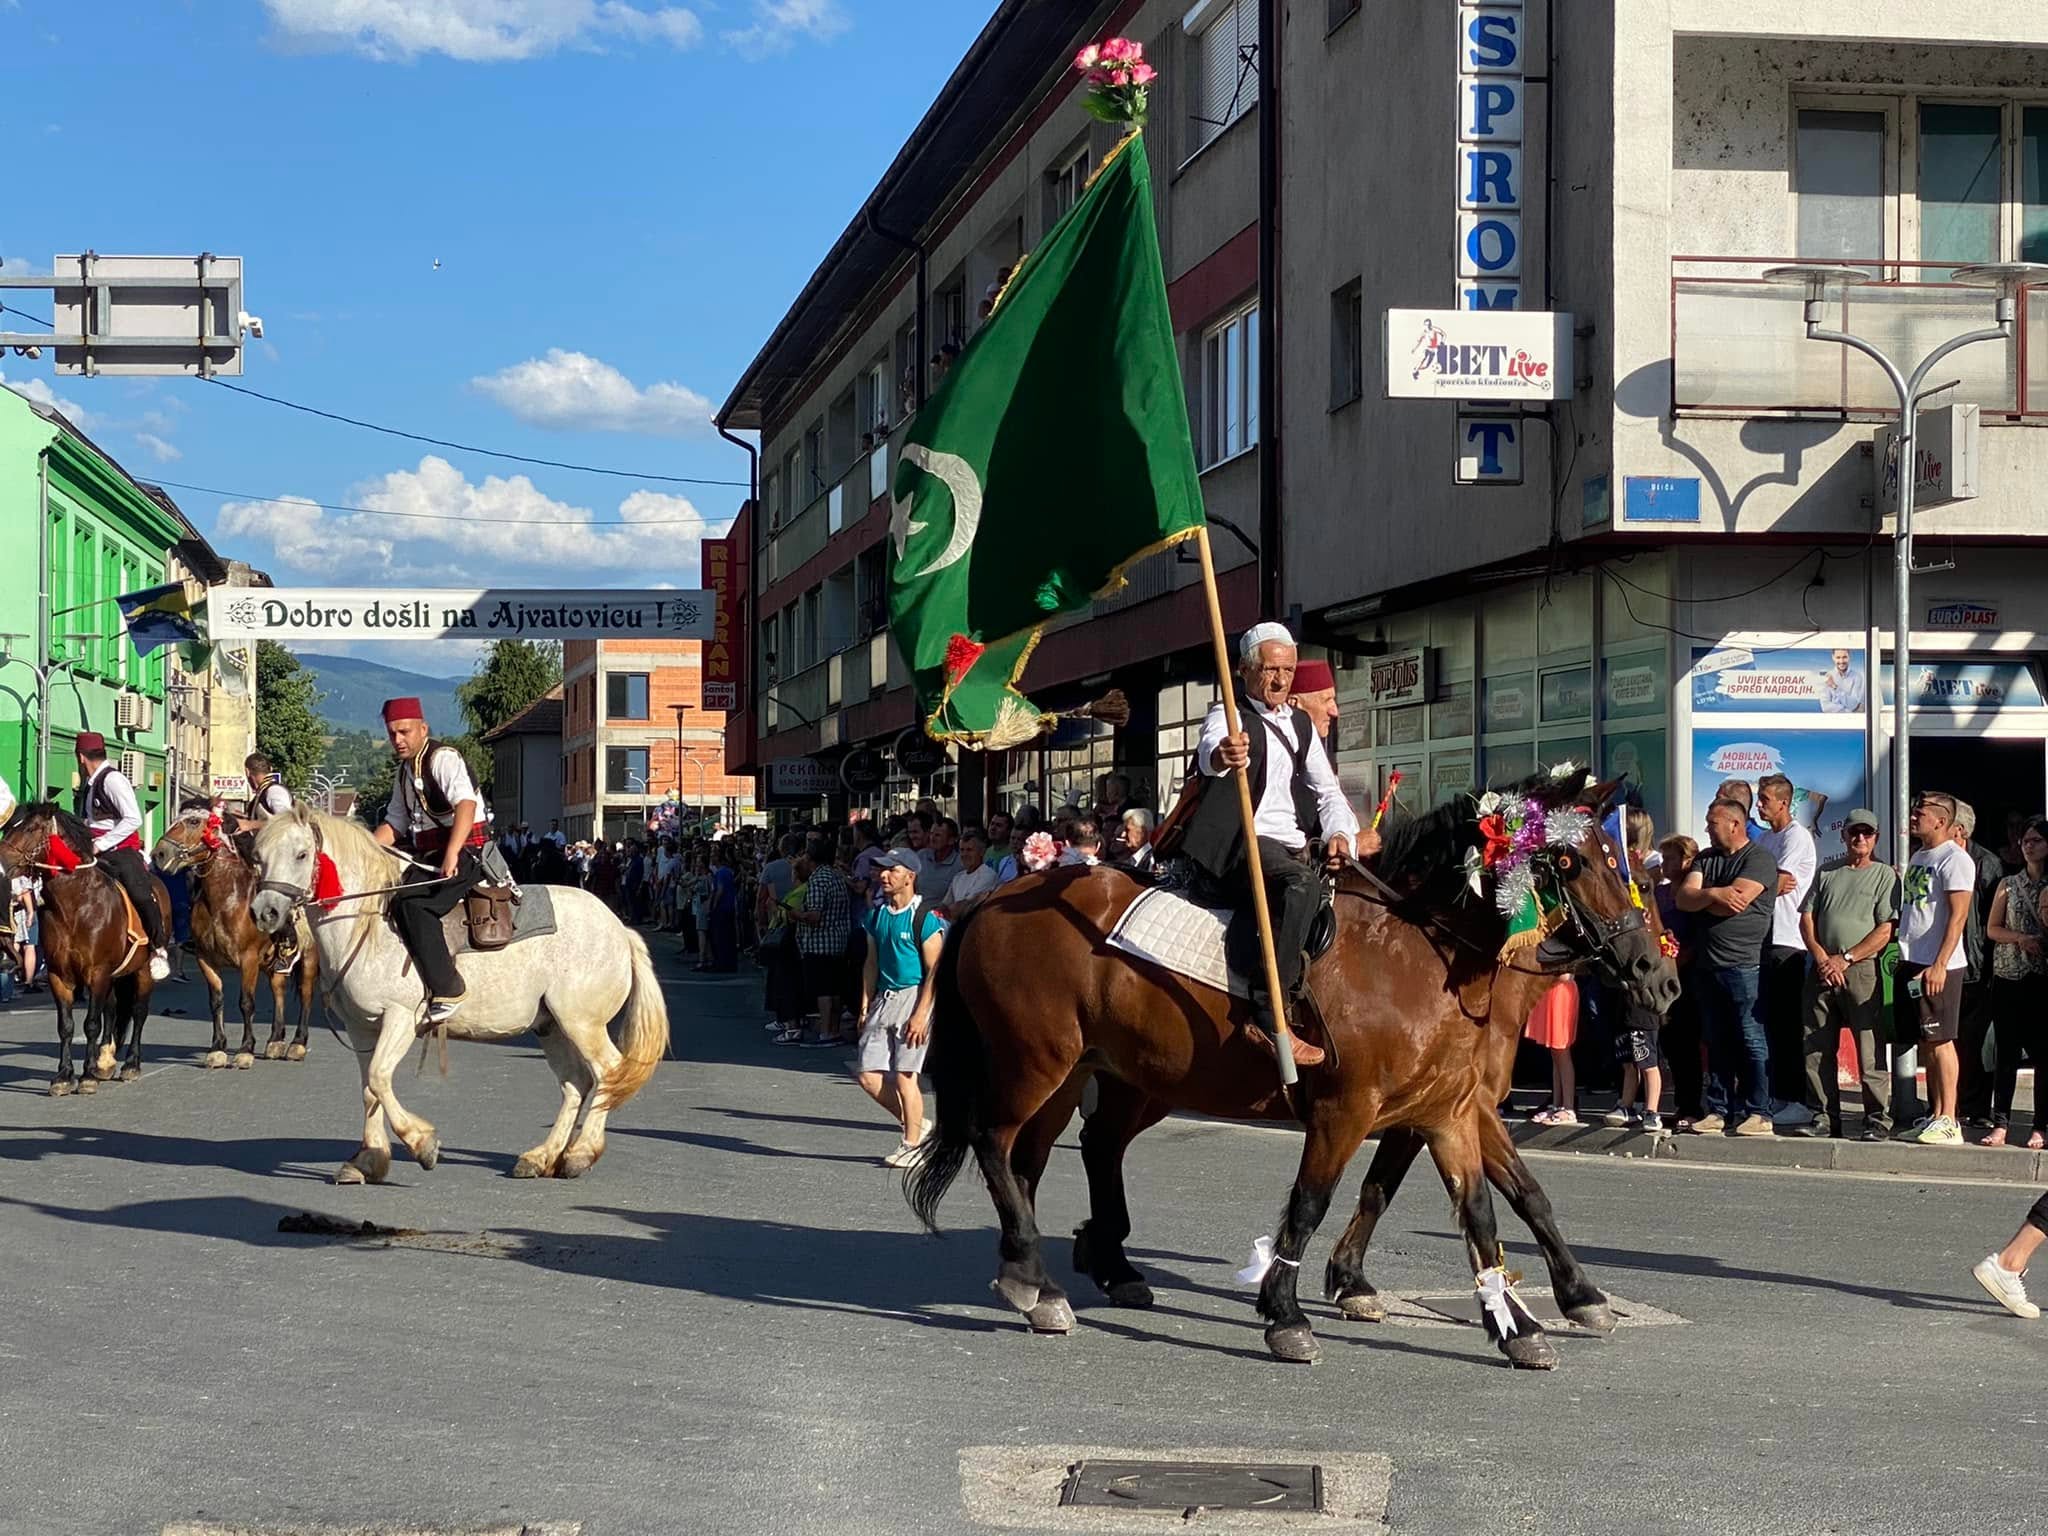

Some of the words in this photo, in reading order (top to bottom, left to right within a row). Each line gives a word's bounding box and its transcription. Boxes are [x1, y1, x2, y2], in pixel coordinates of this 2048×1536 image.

[1466, 15, 1517, 474] SPROT
[1436, 344, 1508, 376] BET
[1508, 351, 1549, 377] Live
[261, 599, 353, 628] Dobro
[363, 599, 431, 628] došli
[442, 607, 478, 628] na
[488, 600, 643, 634] Ajvatovicu
[655, 601, 665, 628] !
[709, 545, 730, 676] RESTORAN
[1929, 609, 1961, 625] EURO
[1963, 610, 1998, 625] PLAST
[1737, 675, 1769, 687] UVIJEK
[1771, 675, 1806, 685] KORAK
[1932, 679, 1974, 696] BET
[1727, 684, 1762, 695] ISPRED
[1763, 684, 1816, 696] NAJBOLJIH.
[1721, 751, 1769, 762] MOBILNA
[1717, 761, 1774, 773] APLIKACIJA
[213, 779, 245, 787] MERSY
